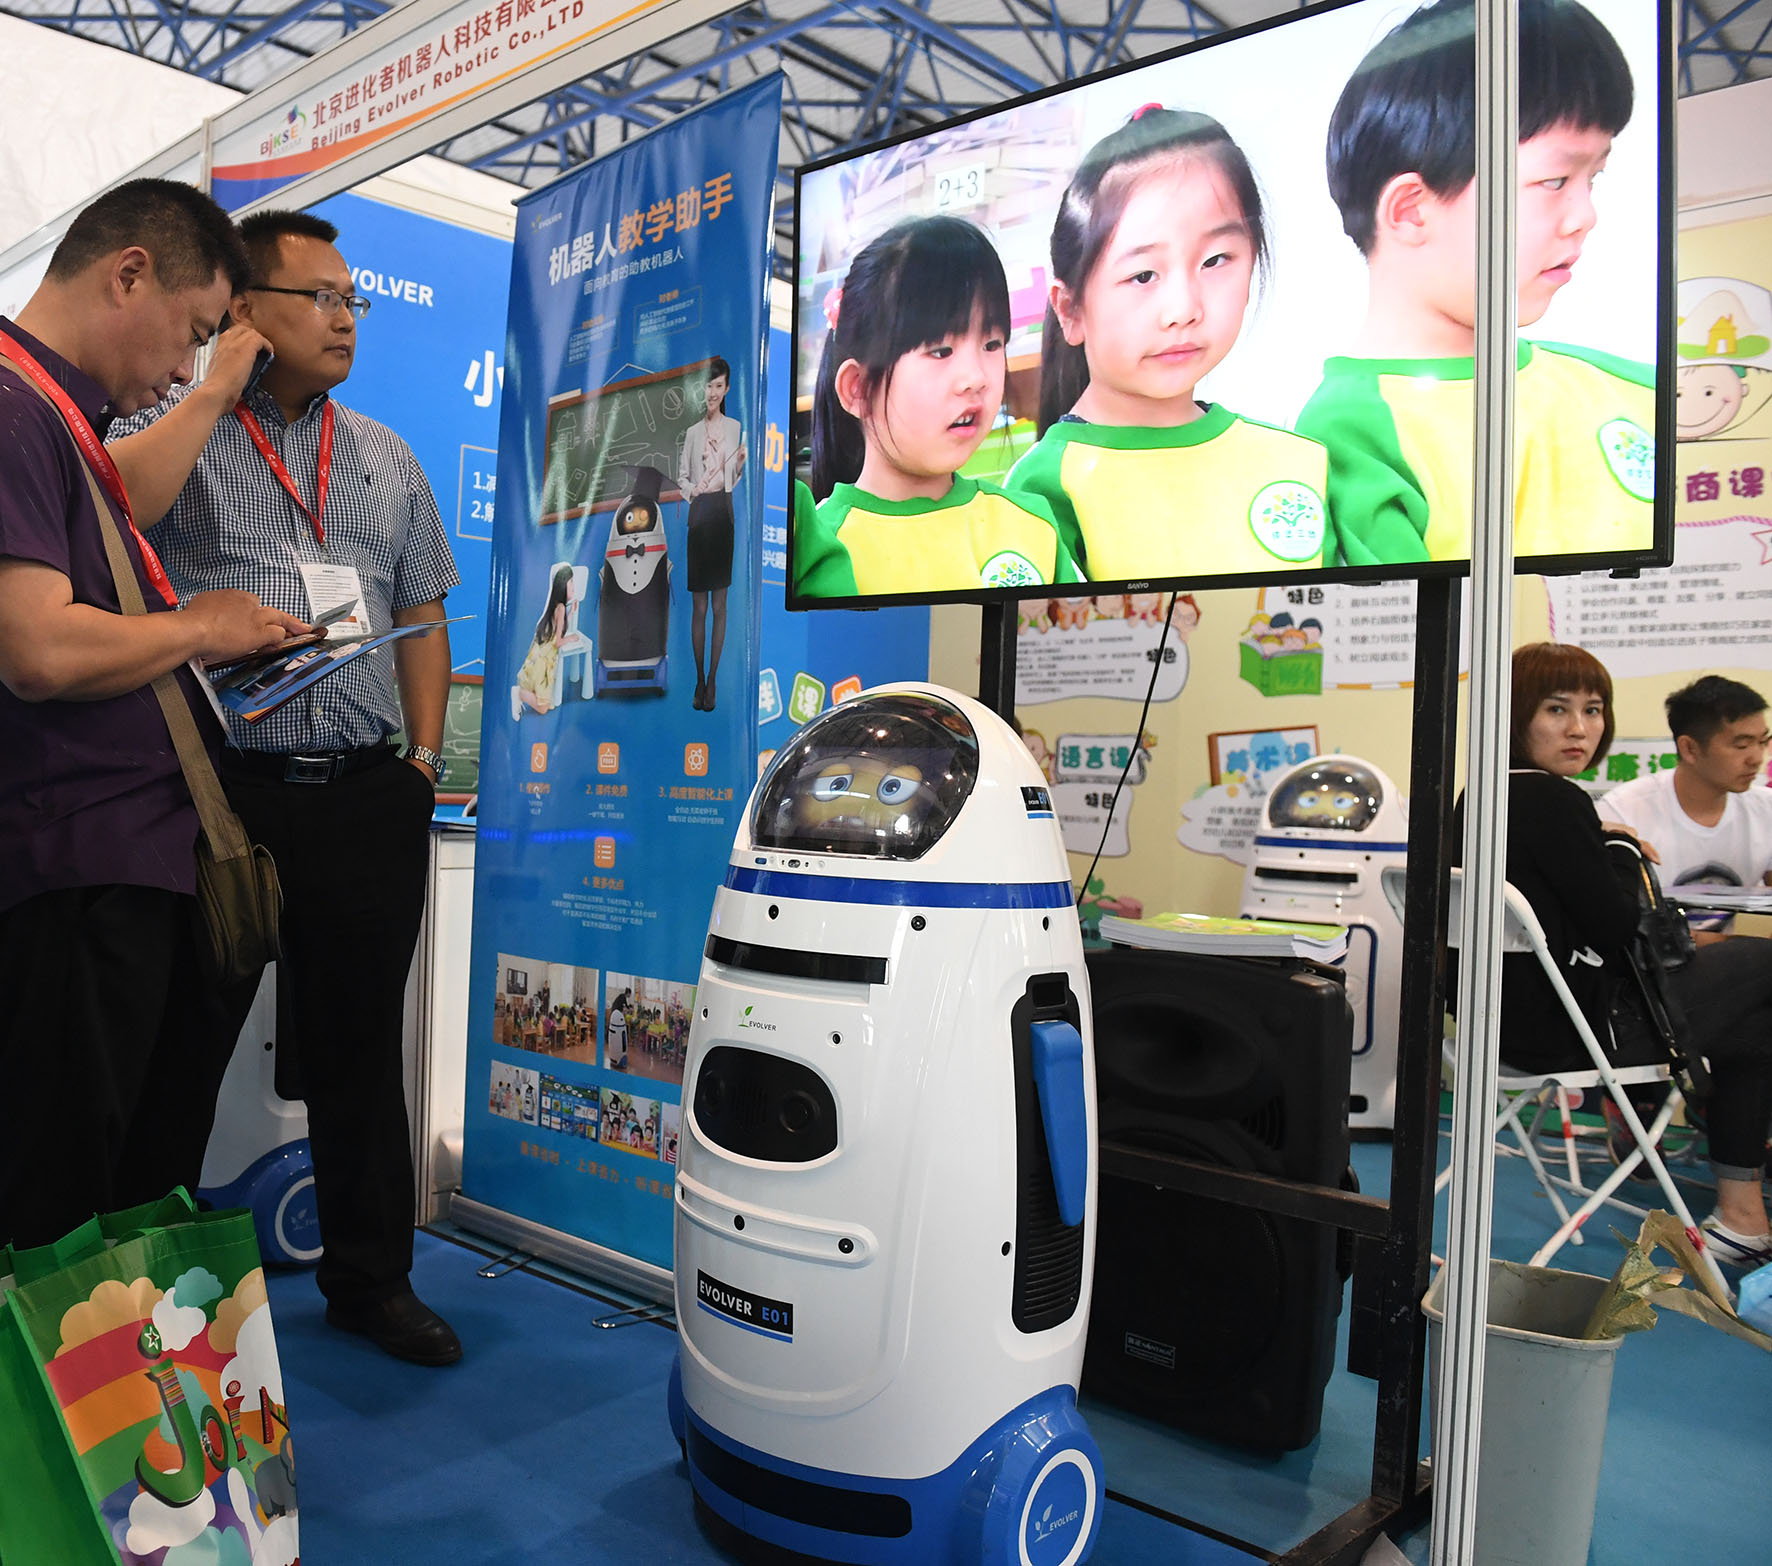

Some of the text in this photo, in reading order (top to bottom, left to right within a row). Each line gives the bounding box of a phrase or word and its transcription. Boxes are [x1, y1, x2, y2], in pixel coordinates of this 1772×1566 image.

[311, 118, 360, 151] Beijing
[368, 84, 425, 123] Evolver
[433, 47, 499, 89] Robotic
[508, 0, 584, 50] Co.,LTD
[549, 172, 734, 286] 机器人教学助手
[346, 263, 433, 307] VOLVER
[1062, 745, 1130, 768] 语言课
[749, 1020, 777, 1031] EVOLVER
[700, 1280, 788, 1326] EVOLVER E01
[1050, 1510, 1078, 1531] EVOLVER
